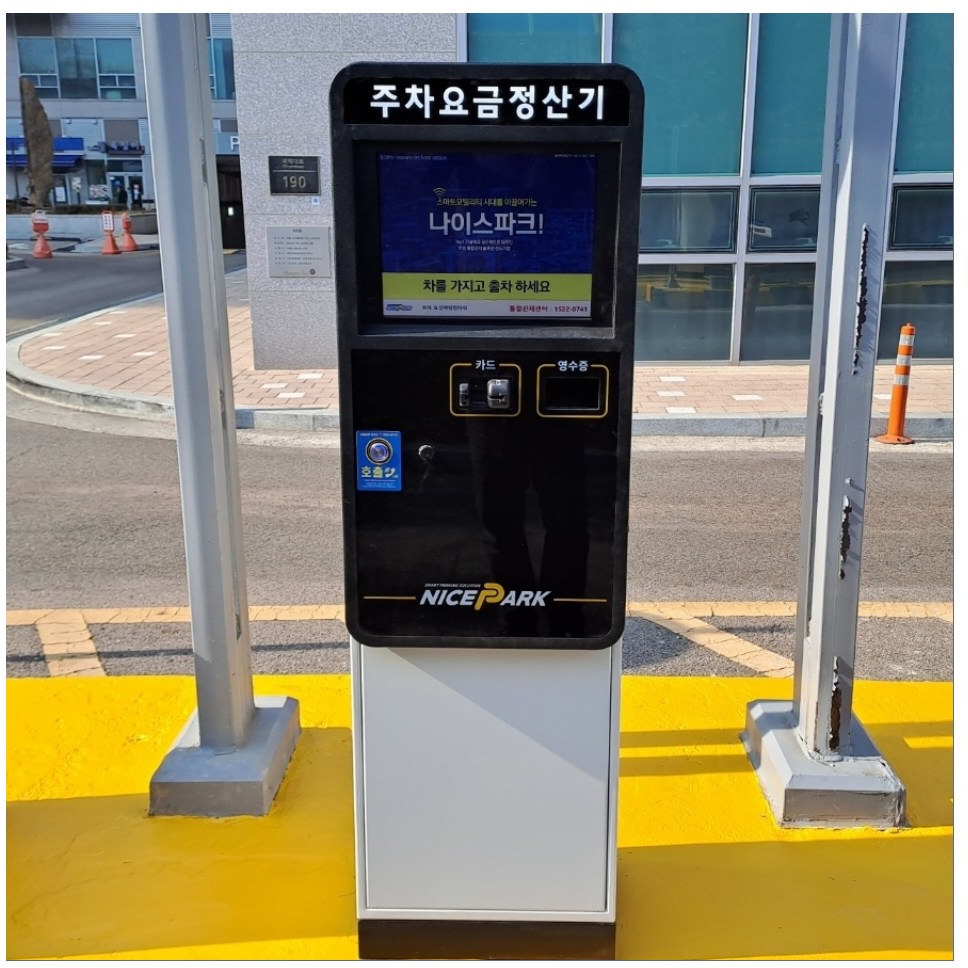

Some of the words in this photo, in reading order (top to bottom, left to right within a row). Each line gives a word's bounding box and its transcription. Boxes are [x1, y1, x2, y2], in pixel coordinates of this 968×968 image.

[370, 84, 605, 119] 주차요금정산기
[282, 176, 306, 188] 190
[484, 198, 503, 207] 시대를
[429, 212, 543, 236] 나이스파크!
[423, 280, 447, 293] 차를
[450, 280, 485, 293] 가지고
[489, 280, 512, 293] 출차
[515, 280, 550, 293] 하세요
[554, 304, 588, 313] 1522-0741
[475, 359, 496, 371] 카드
[557, 361, 590, 372] 영수증
[361, 466, 383, 478] 호출
[419, 582, 552, 610] NICEPARK
